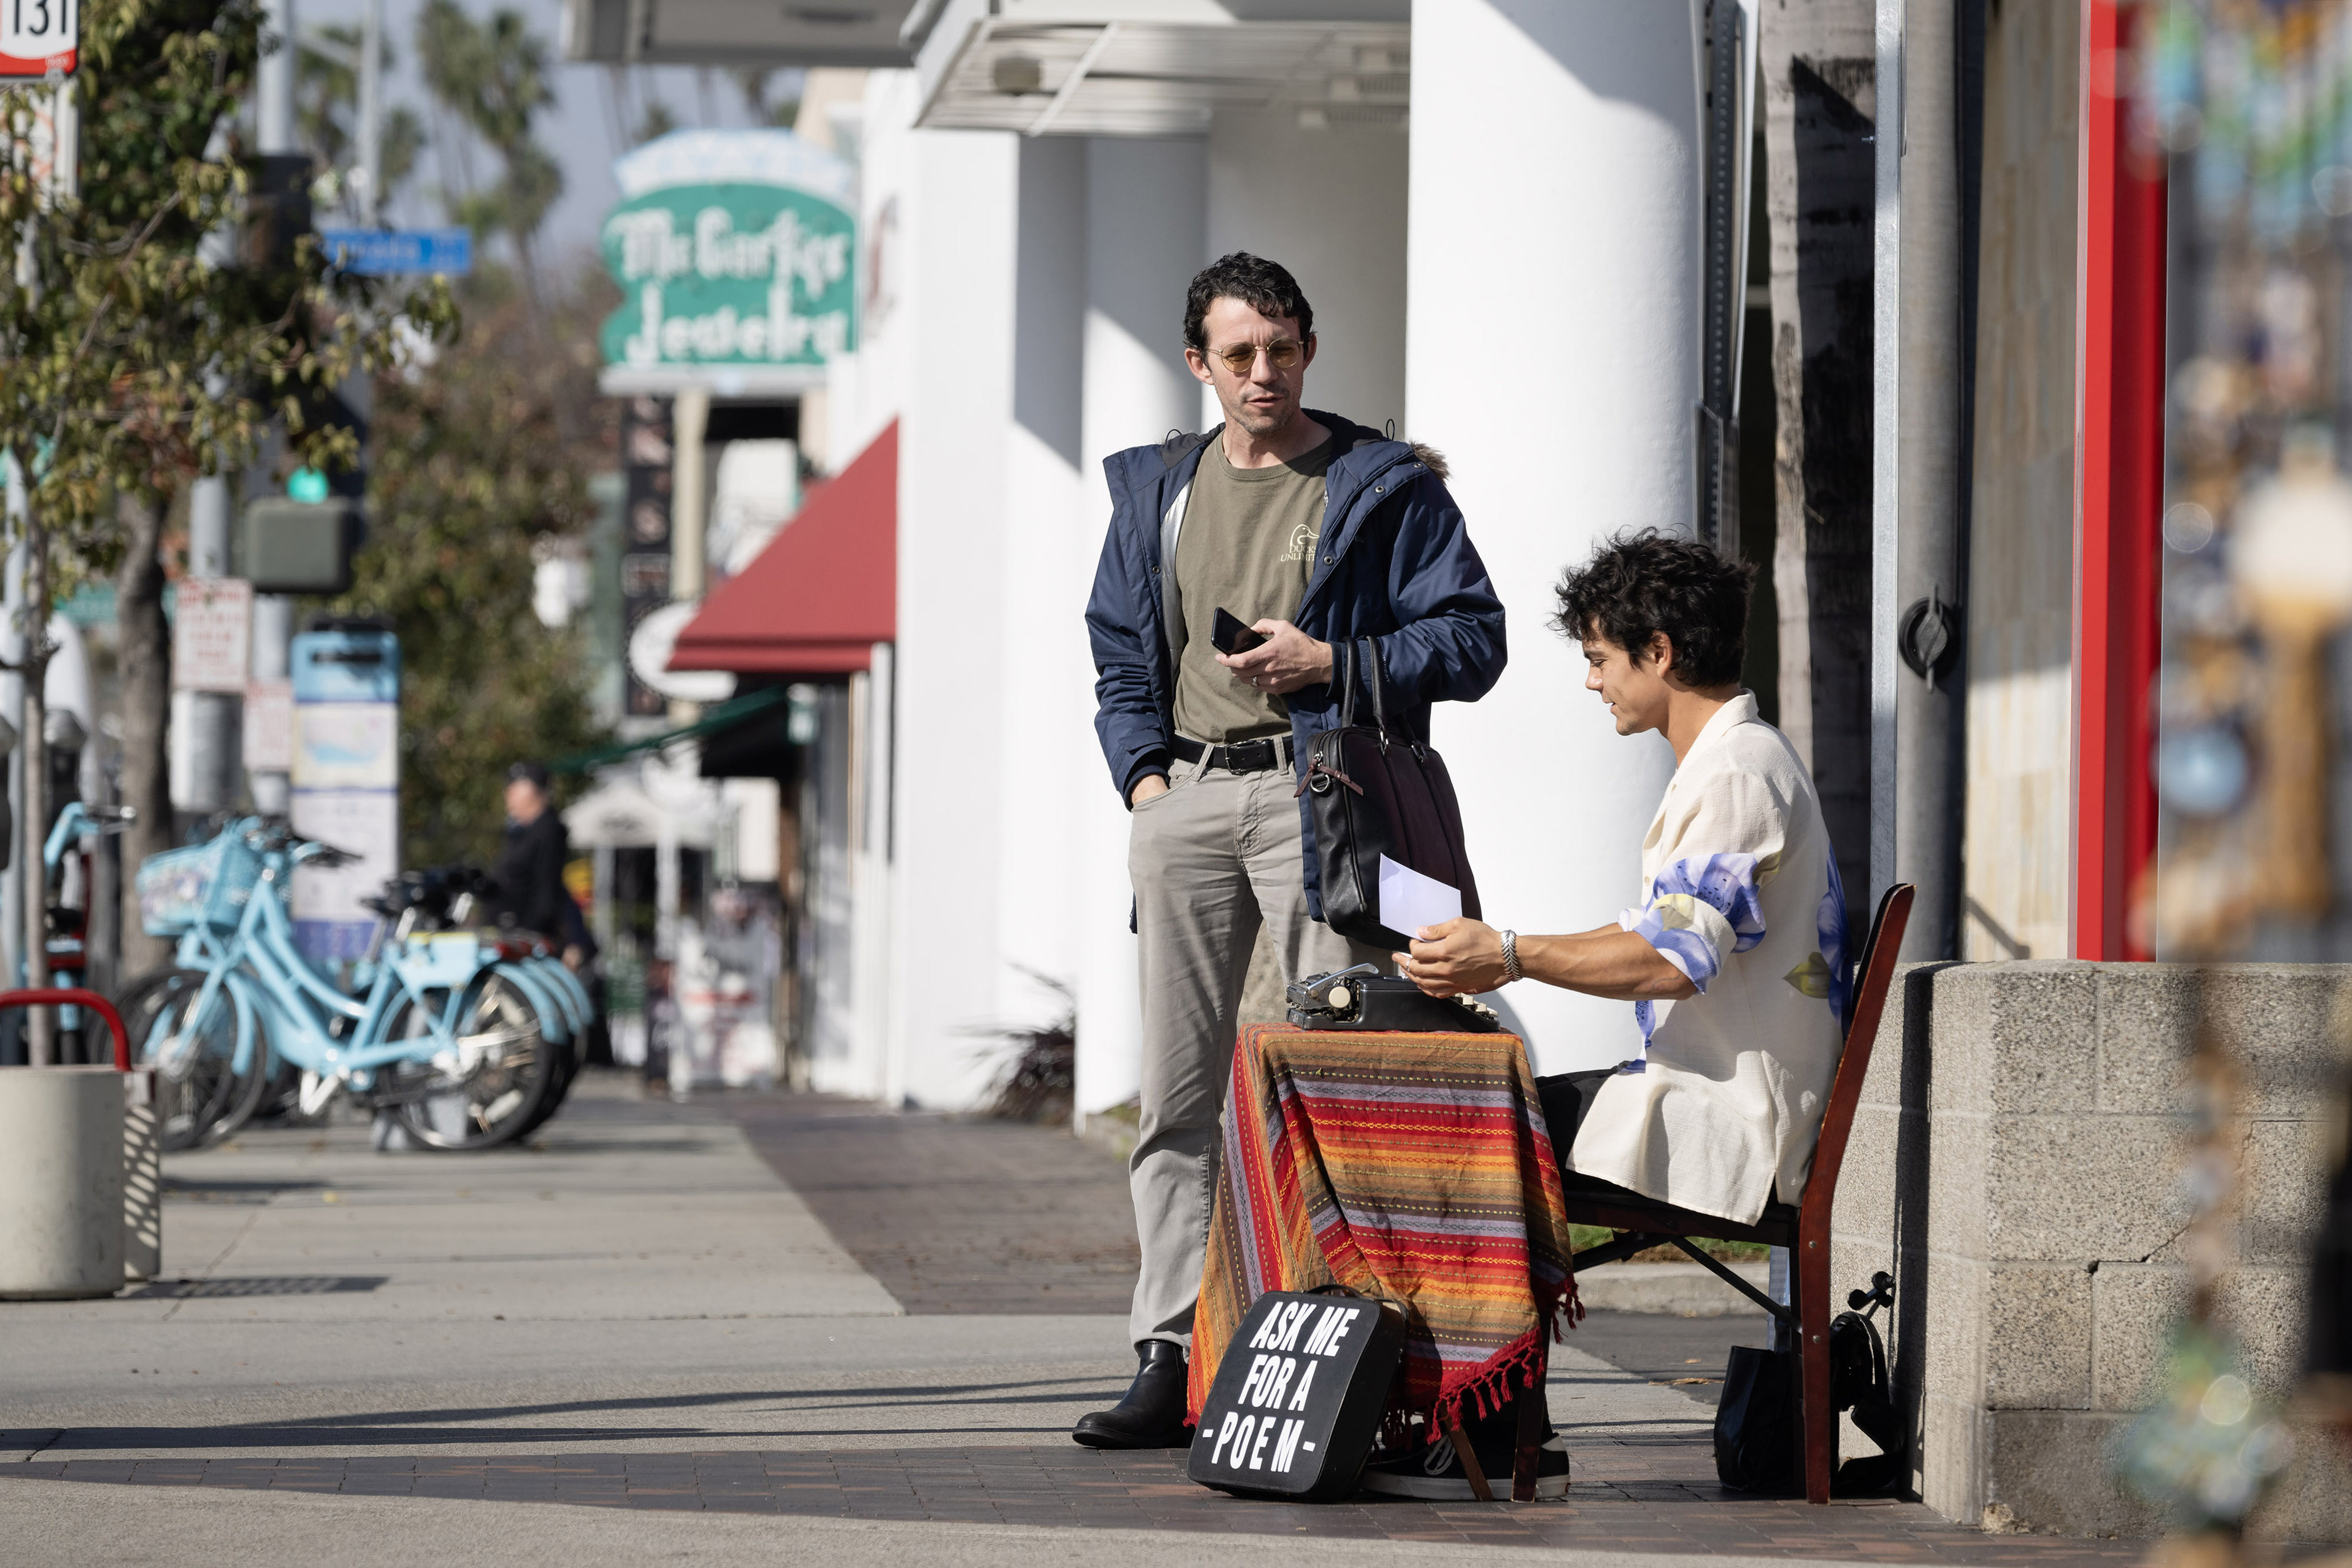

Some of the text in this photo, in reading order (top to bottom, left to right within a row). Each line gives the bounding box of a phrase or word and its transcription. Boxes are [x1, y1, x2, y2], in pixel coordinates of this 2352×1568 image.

[1289, 545, 1316, 554] DUCKS
[1249, 1301, 1360, 1357] ASK ME
[1238, 1354, 1318, 1411] FOR A
